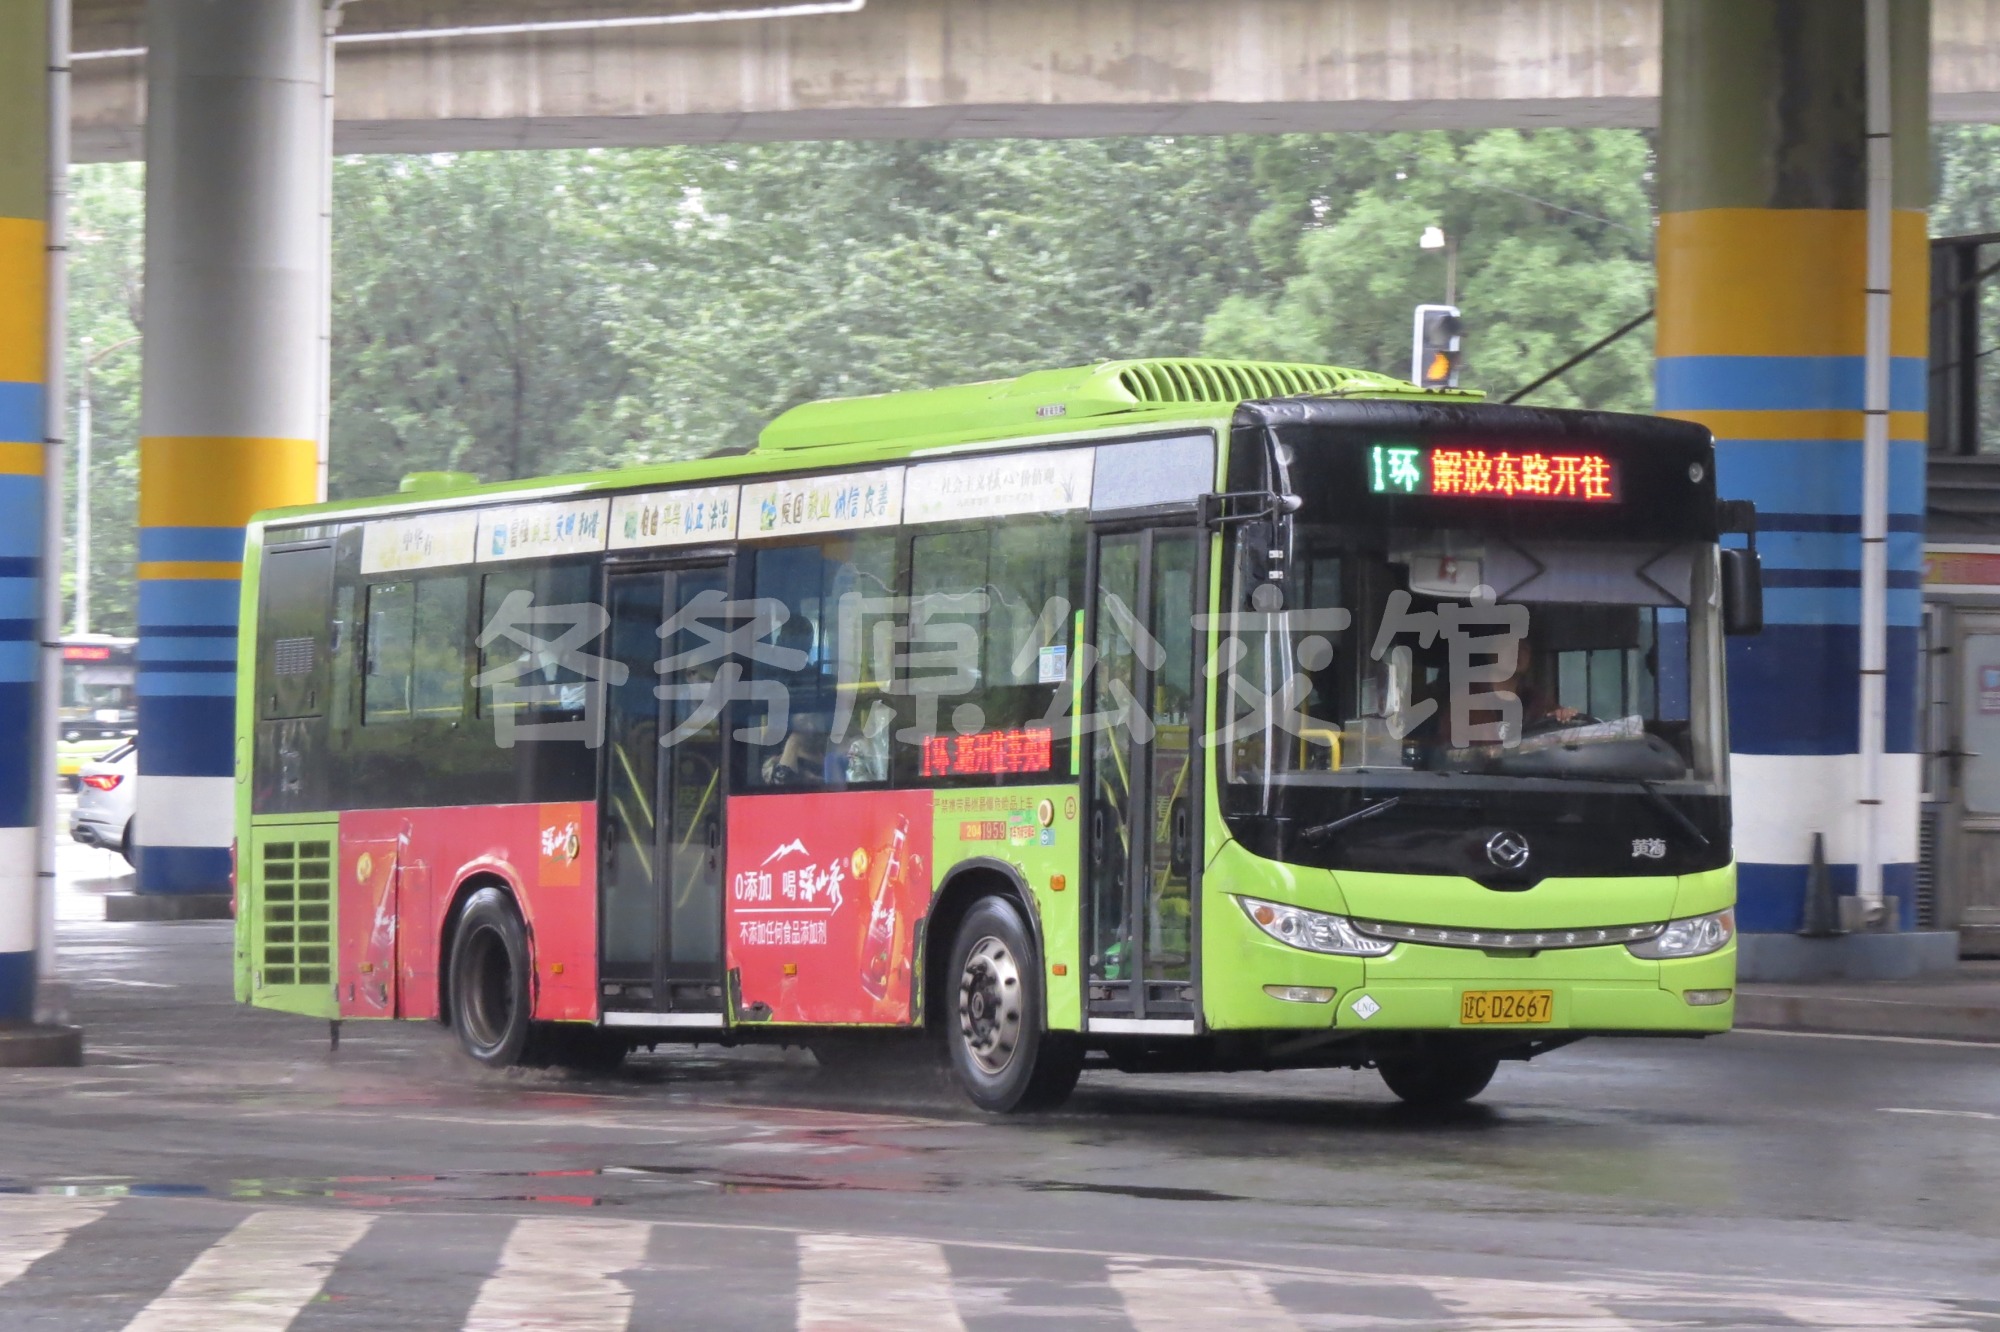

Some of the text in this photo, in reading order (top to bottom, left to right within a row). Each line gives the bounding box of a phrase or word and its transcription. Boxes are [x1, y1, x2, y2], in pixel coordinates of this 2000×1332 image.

[1373, 446, 1612, 499] 1环 解放东路开往
[1631, 838, 1667, 858] 黄海
[735, 871, 772, 902] 0添加
[740, 920, 827, 945] 不添加任何食品添加剂
[1356, 1002, 1375, 1013] LNG
